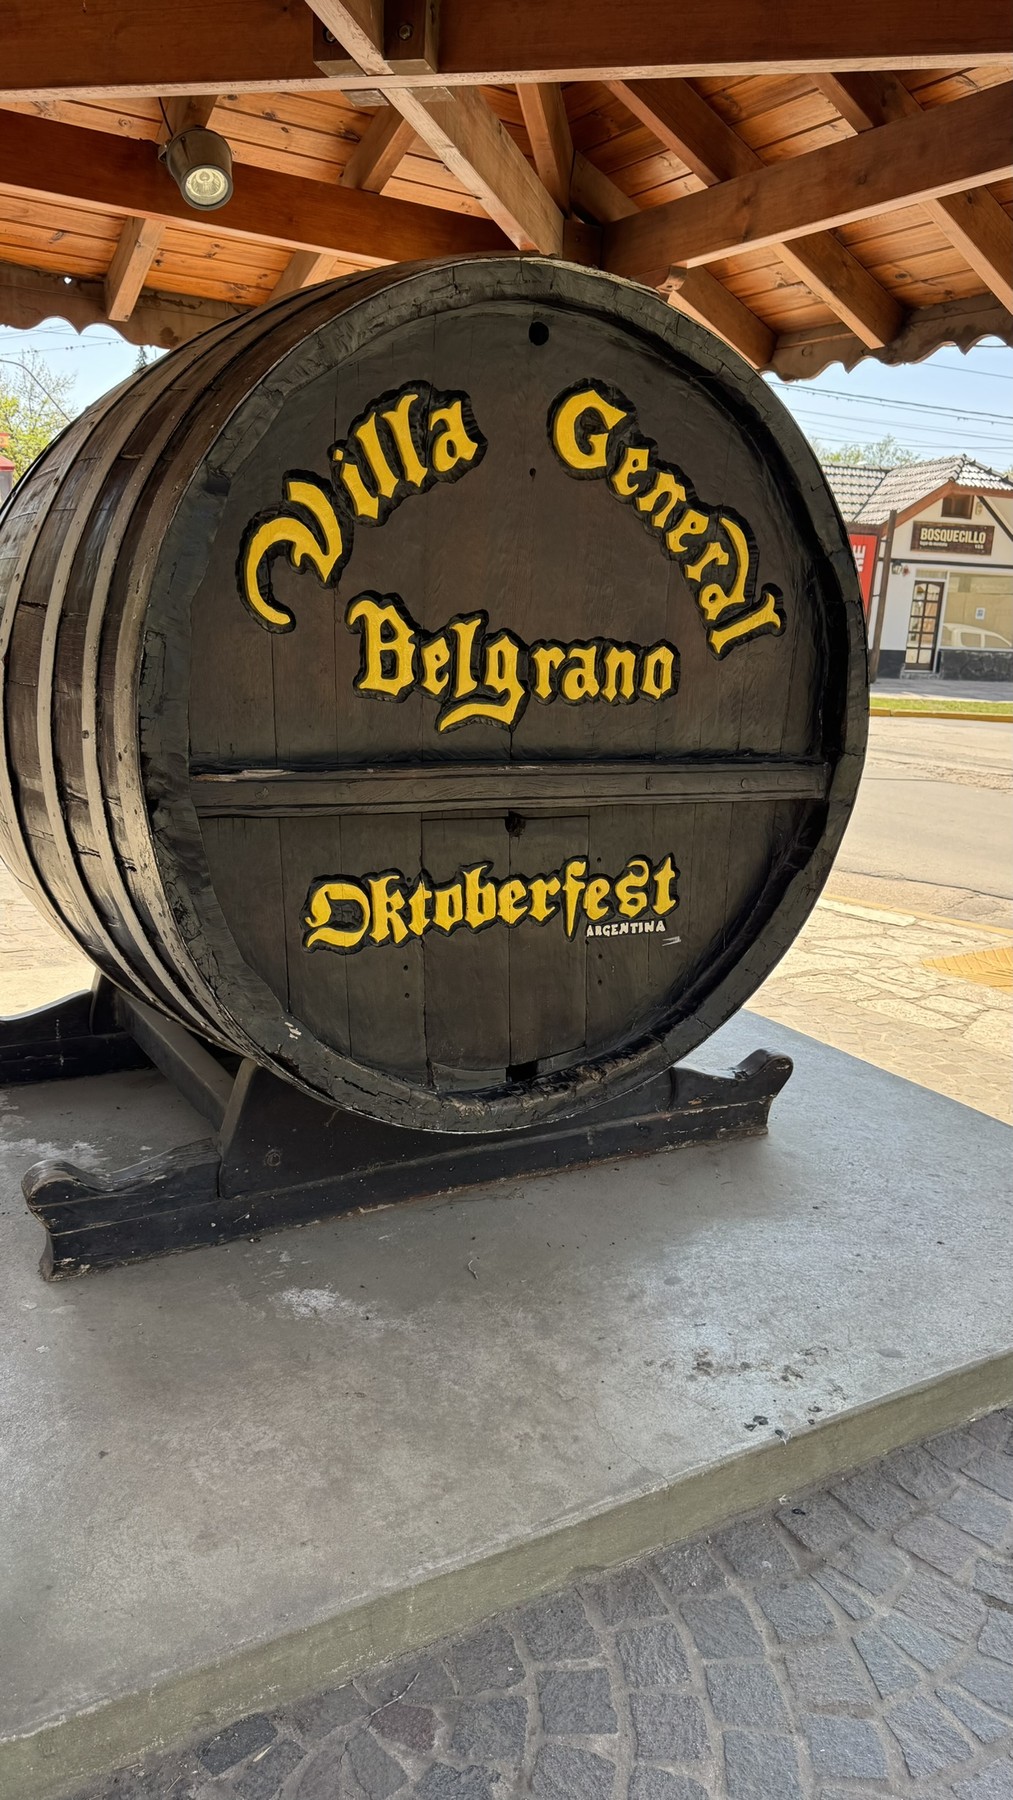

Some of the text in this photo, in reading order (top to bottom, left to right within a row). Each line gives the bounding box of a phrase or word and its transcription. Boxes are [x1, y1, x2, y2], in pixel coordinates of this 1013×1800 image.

[245, 389, 781, 655] Villa General
[920, 527, 986, 544] BOSQUECILLO
[350, 600, 674, 731] Belgrano
[305, 857, 676, 948] Oktoberfest
[586, 921, 666, 937] ARGENTINA
